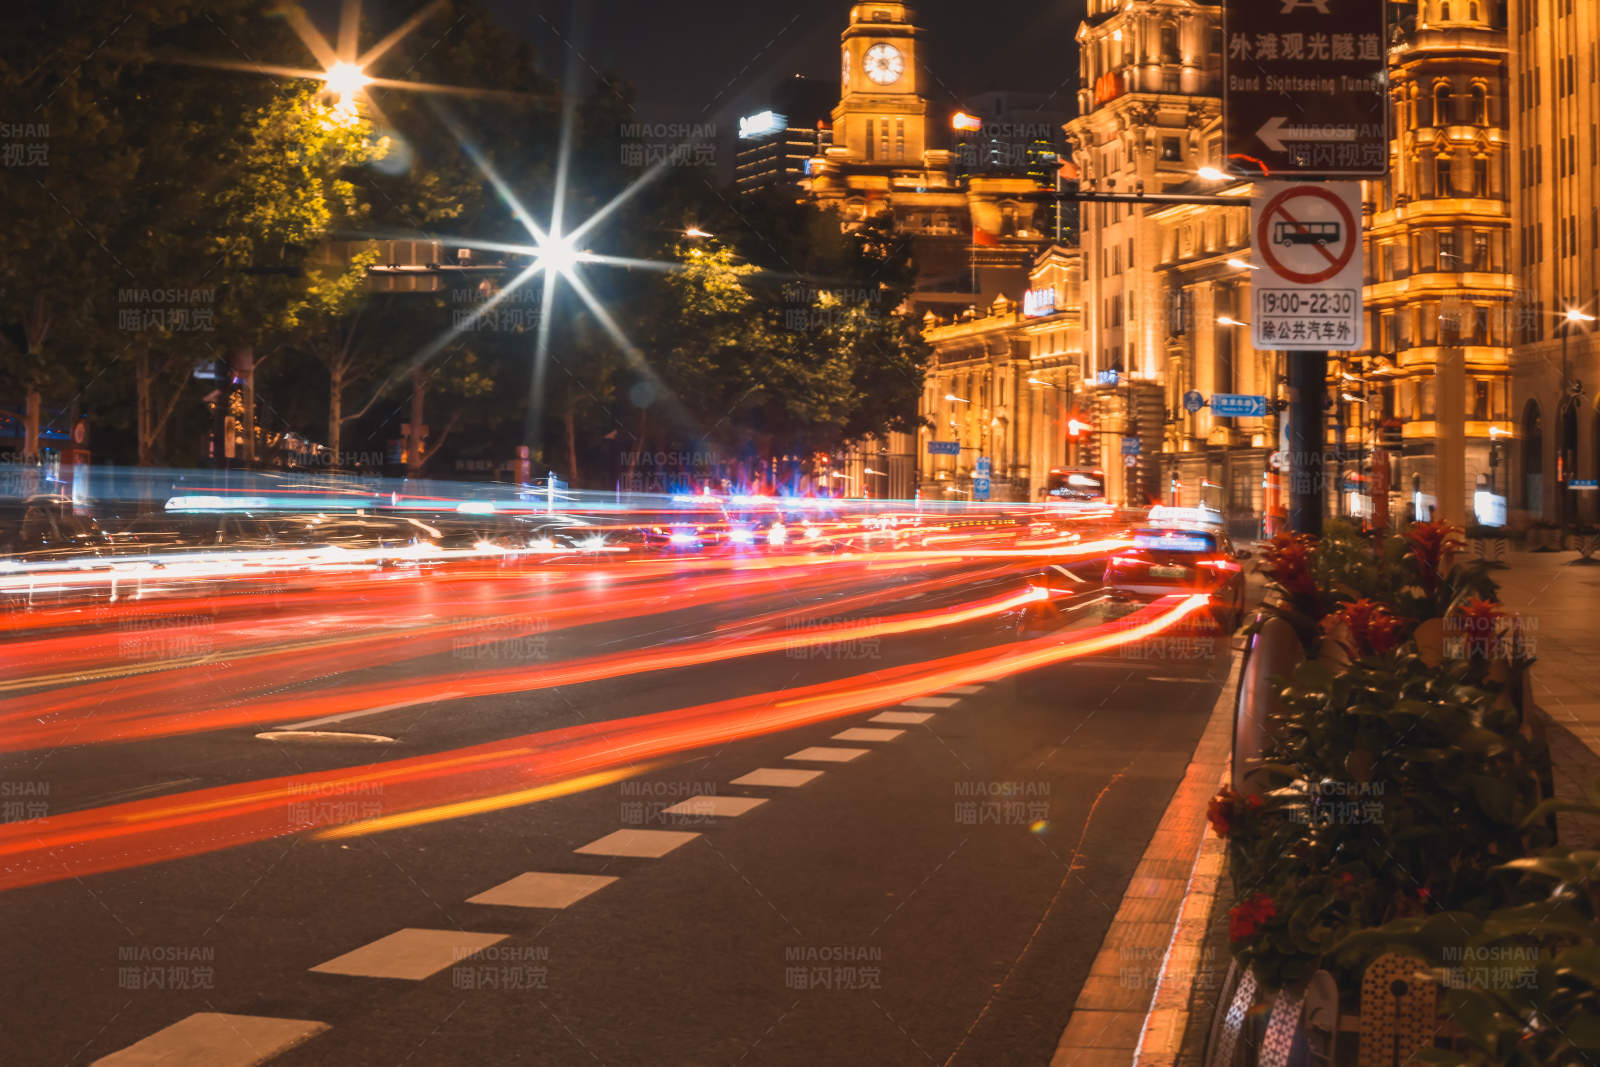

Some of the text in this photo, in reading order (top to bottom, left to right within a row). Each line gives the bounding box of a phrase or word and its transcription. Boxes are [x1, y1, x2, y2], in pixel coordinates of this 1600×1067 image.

[1229, 33, 1380, 61] 外滩观光隧道
[1230, 75, 1260, 91] Bund
[1266, 74, 1336, 96] Sightseeing
[1262, 292, 1351, 314] 19:00-22:30
[1262, 321, 1350, 340] 除公共汽车外
